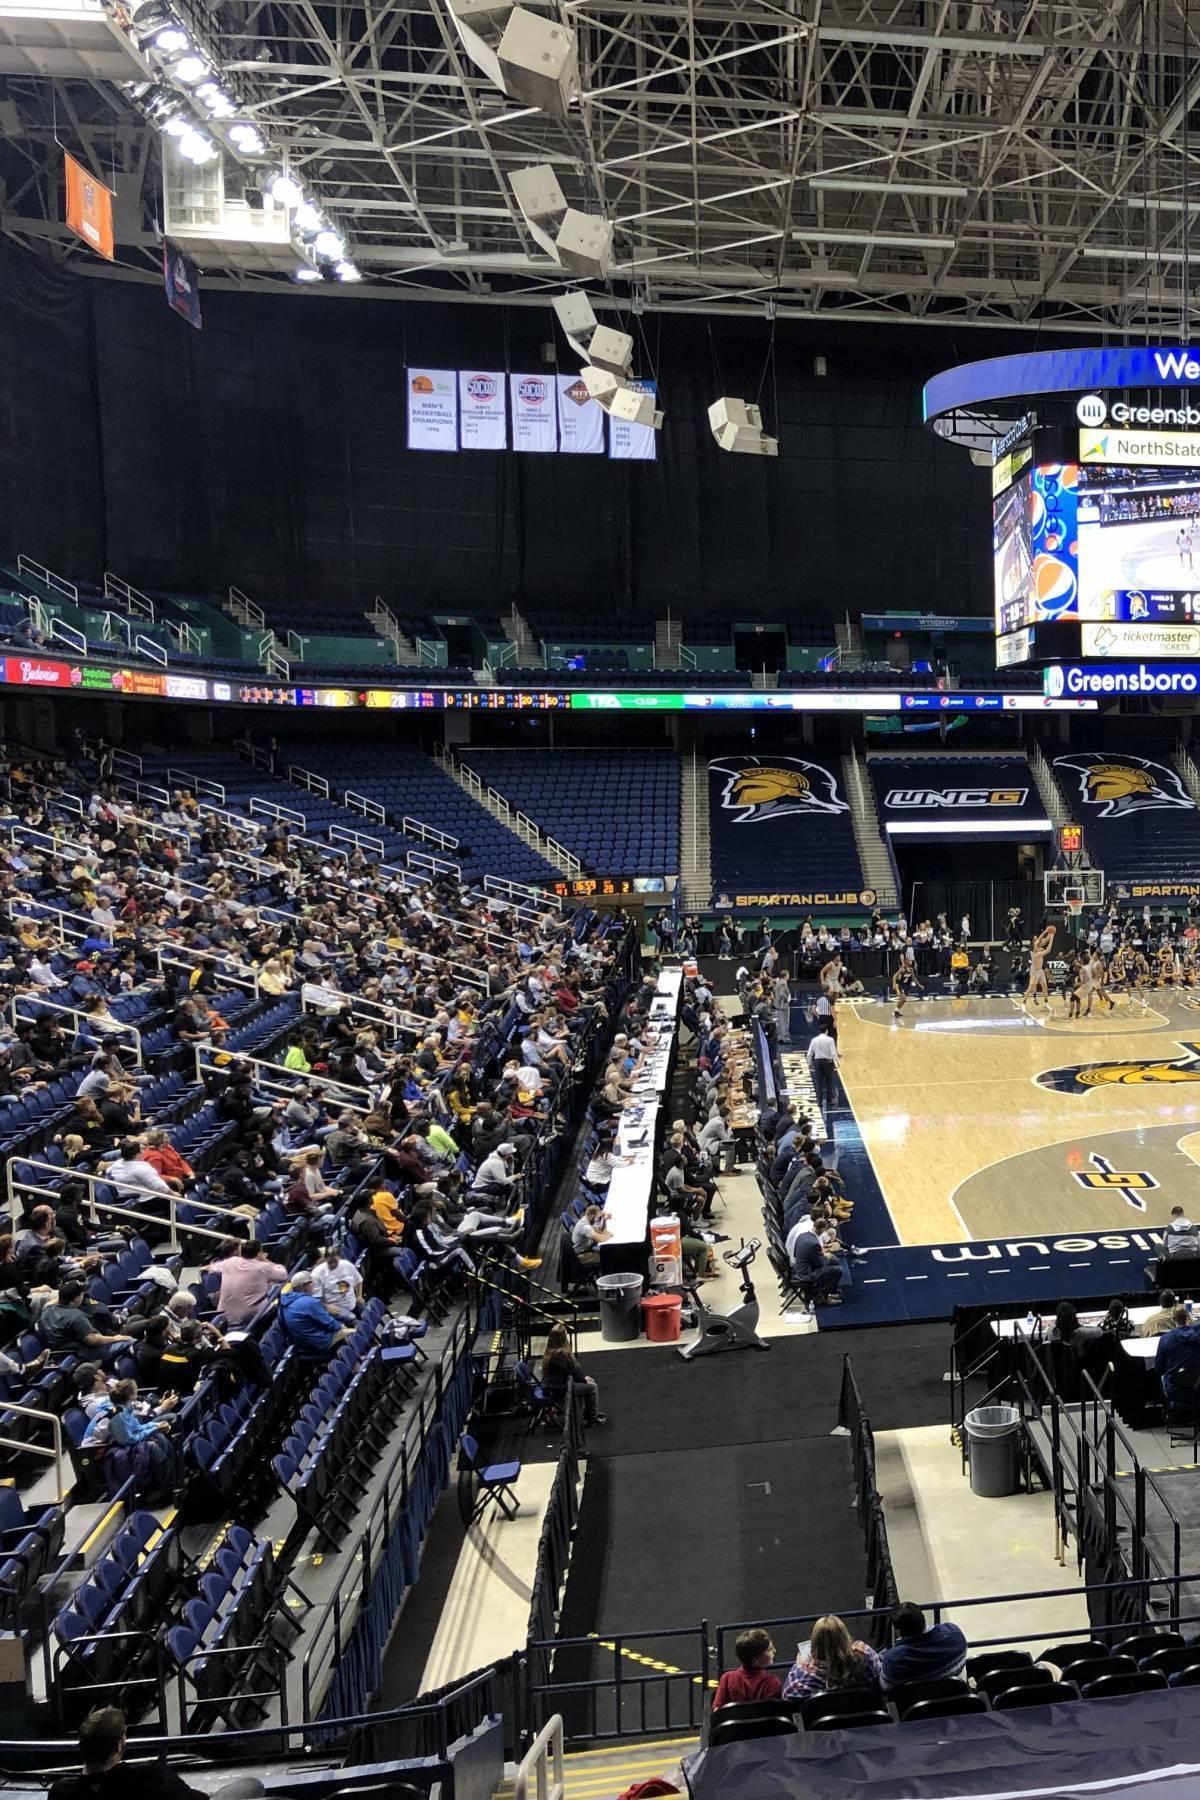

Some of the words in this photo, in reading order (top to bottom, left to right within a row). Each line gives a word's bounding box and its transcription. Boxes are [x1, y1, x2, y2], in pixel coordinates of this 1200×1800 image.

[468, 381, 497, 393] SOCON
[519, 384, 546, 397] SOCON
[1123, 630, 1193, 643] ticketmaster
[1067, 665, 1197, 692] Greensboro
[884, 787, 1030, 809] UNCG
[1062, 836, 1079, 850] 30
[576, 880, 596, 890] 16:59
[1132, 885, 1200, 897] SPARTAN
[736, 894, 812, 906] SPARTAN
[814, 893, 858, 904] CLUB
[656, 1264, 665, 1272] G
